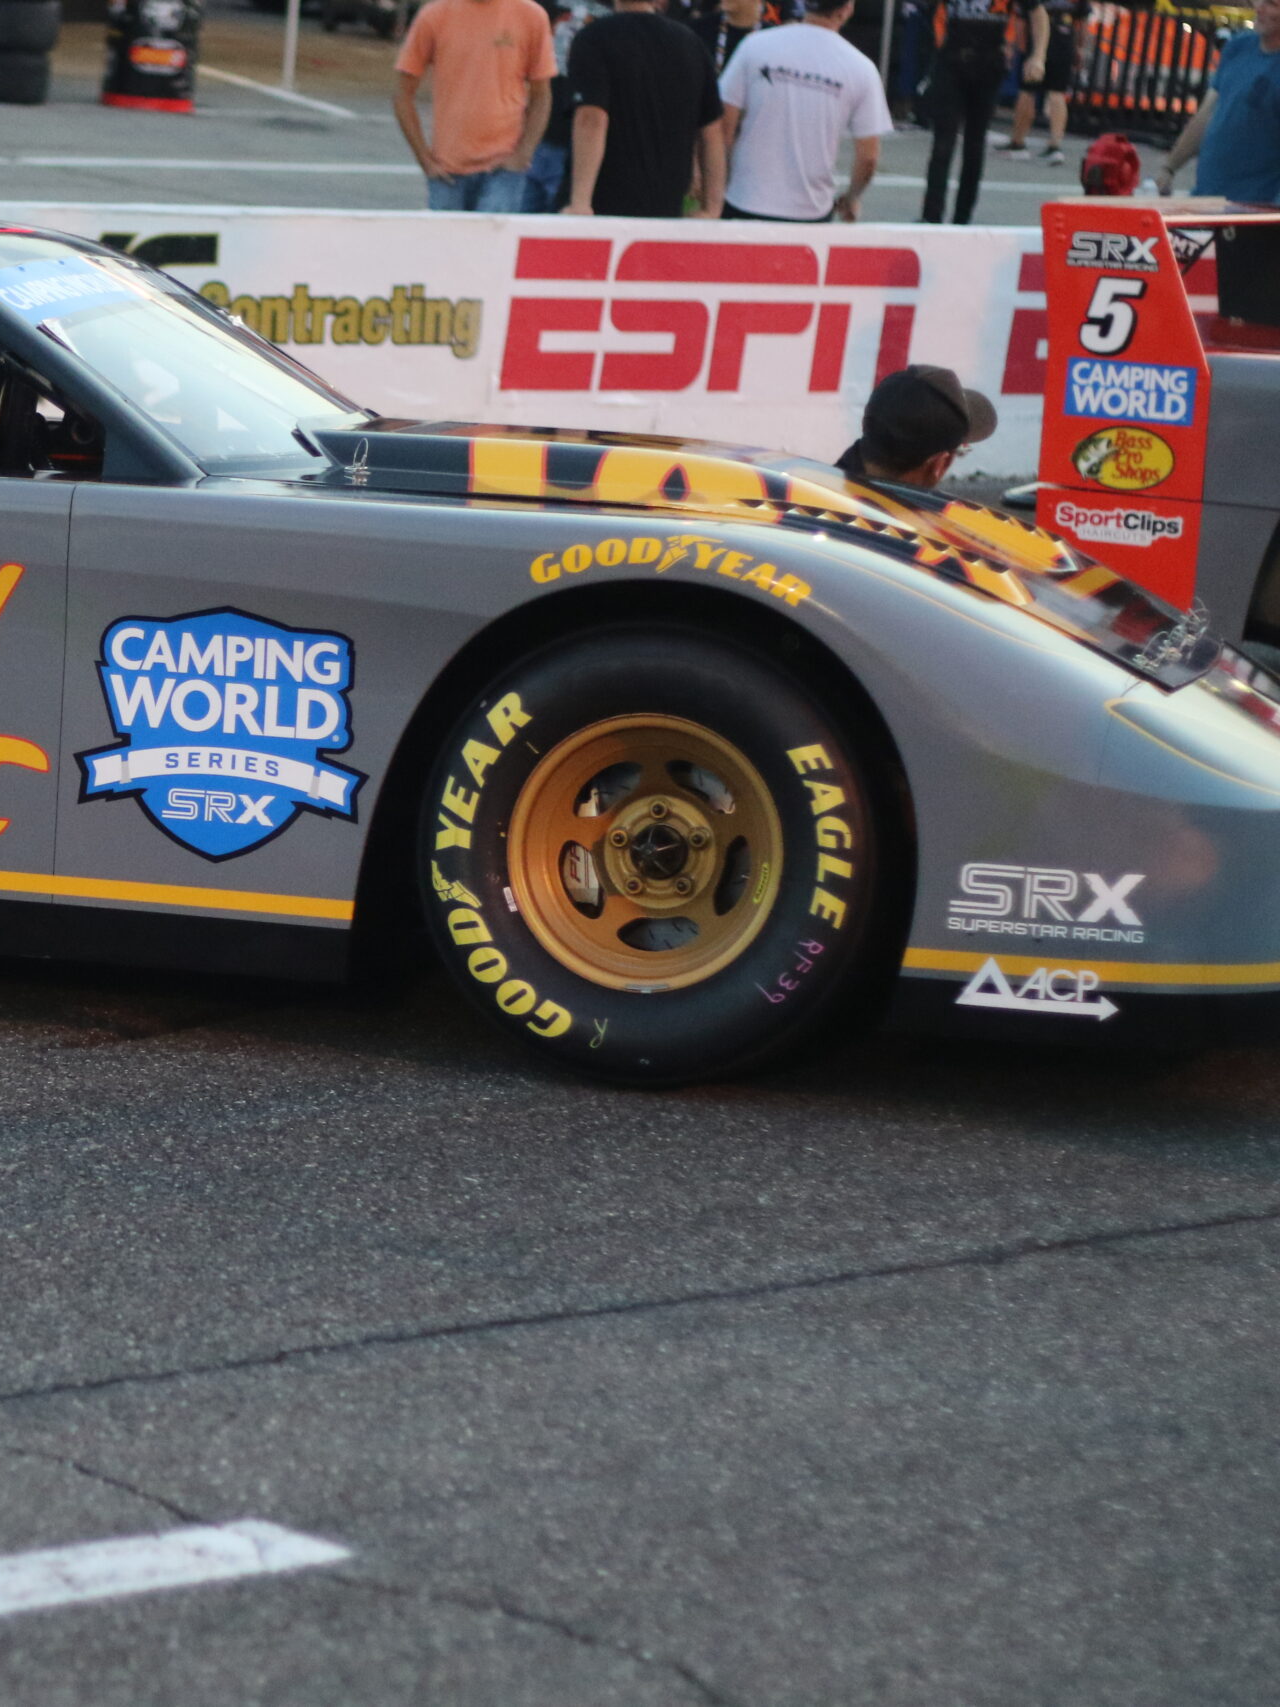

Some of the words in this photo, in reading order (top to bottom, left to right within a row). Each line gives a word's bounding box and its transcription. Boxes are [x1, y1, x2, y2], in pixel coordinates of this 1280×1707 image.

[1067, 231, 1160, 264] SRX
[500, 237, 920, 393] ESPN
[1079, 276, 1147, 356] 5
[1072, 361, 1188, 394] CAMPING
[1072, 385, 1187, 422] WORLD
[1113, 448, 1144, 464] Pro
[1115, 429, 1154, 450] Bass
[1112, 464, 1161, 484] Shops
[1058, 505, 1181, 536] SportClips
[111, 627, 342, 686] CAMPING
[110, 674, 340, 741] WORLD
[164, 752, 280, 778] SERIES
[161, 787, 277, 828] SRX
[786, 743, 853, 929] EAGLE
[948, 862, 1147, 927] SRX
[947, 917, 1067, 939] SUPERSTAR
[1072, 925, 1145, 944] RACING
[1015, 967, 1100, 1003] ACP
